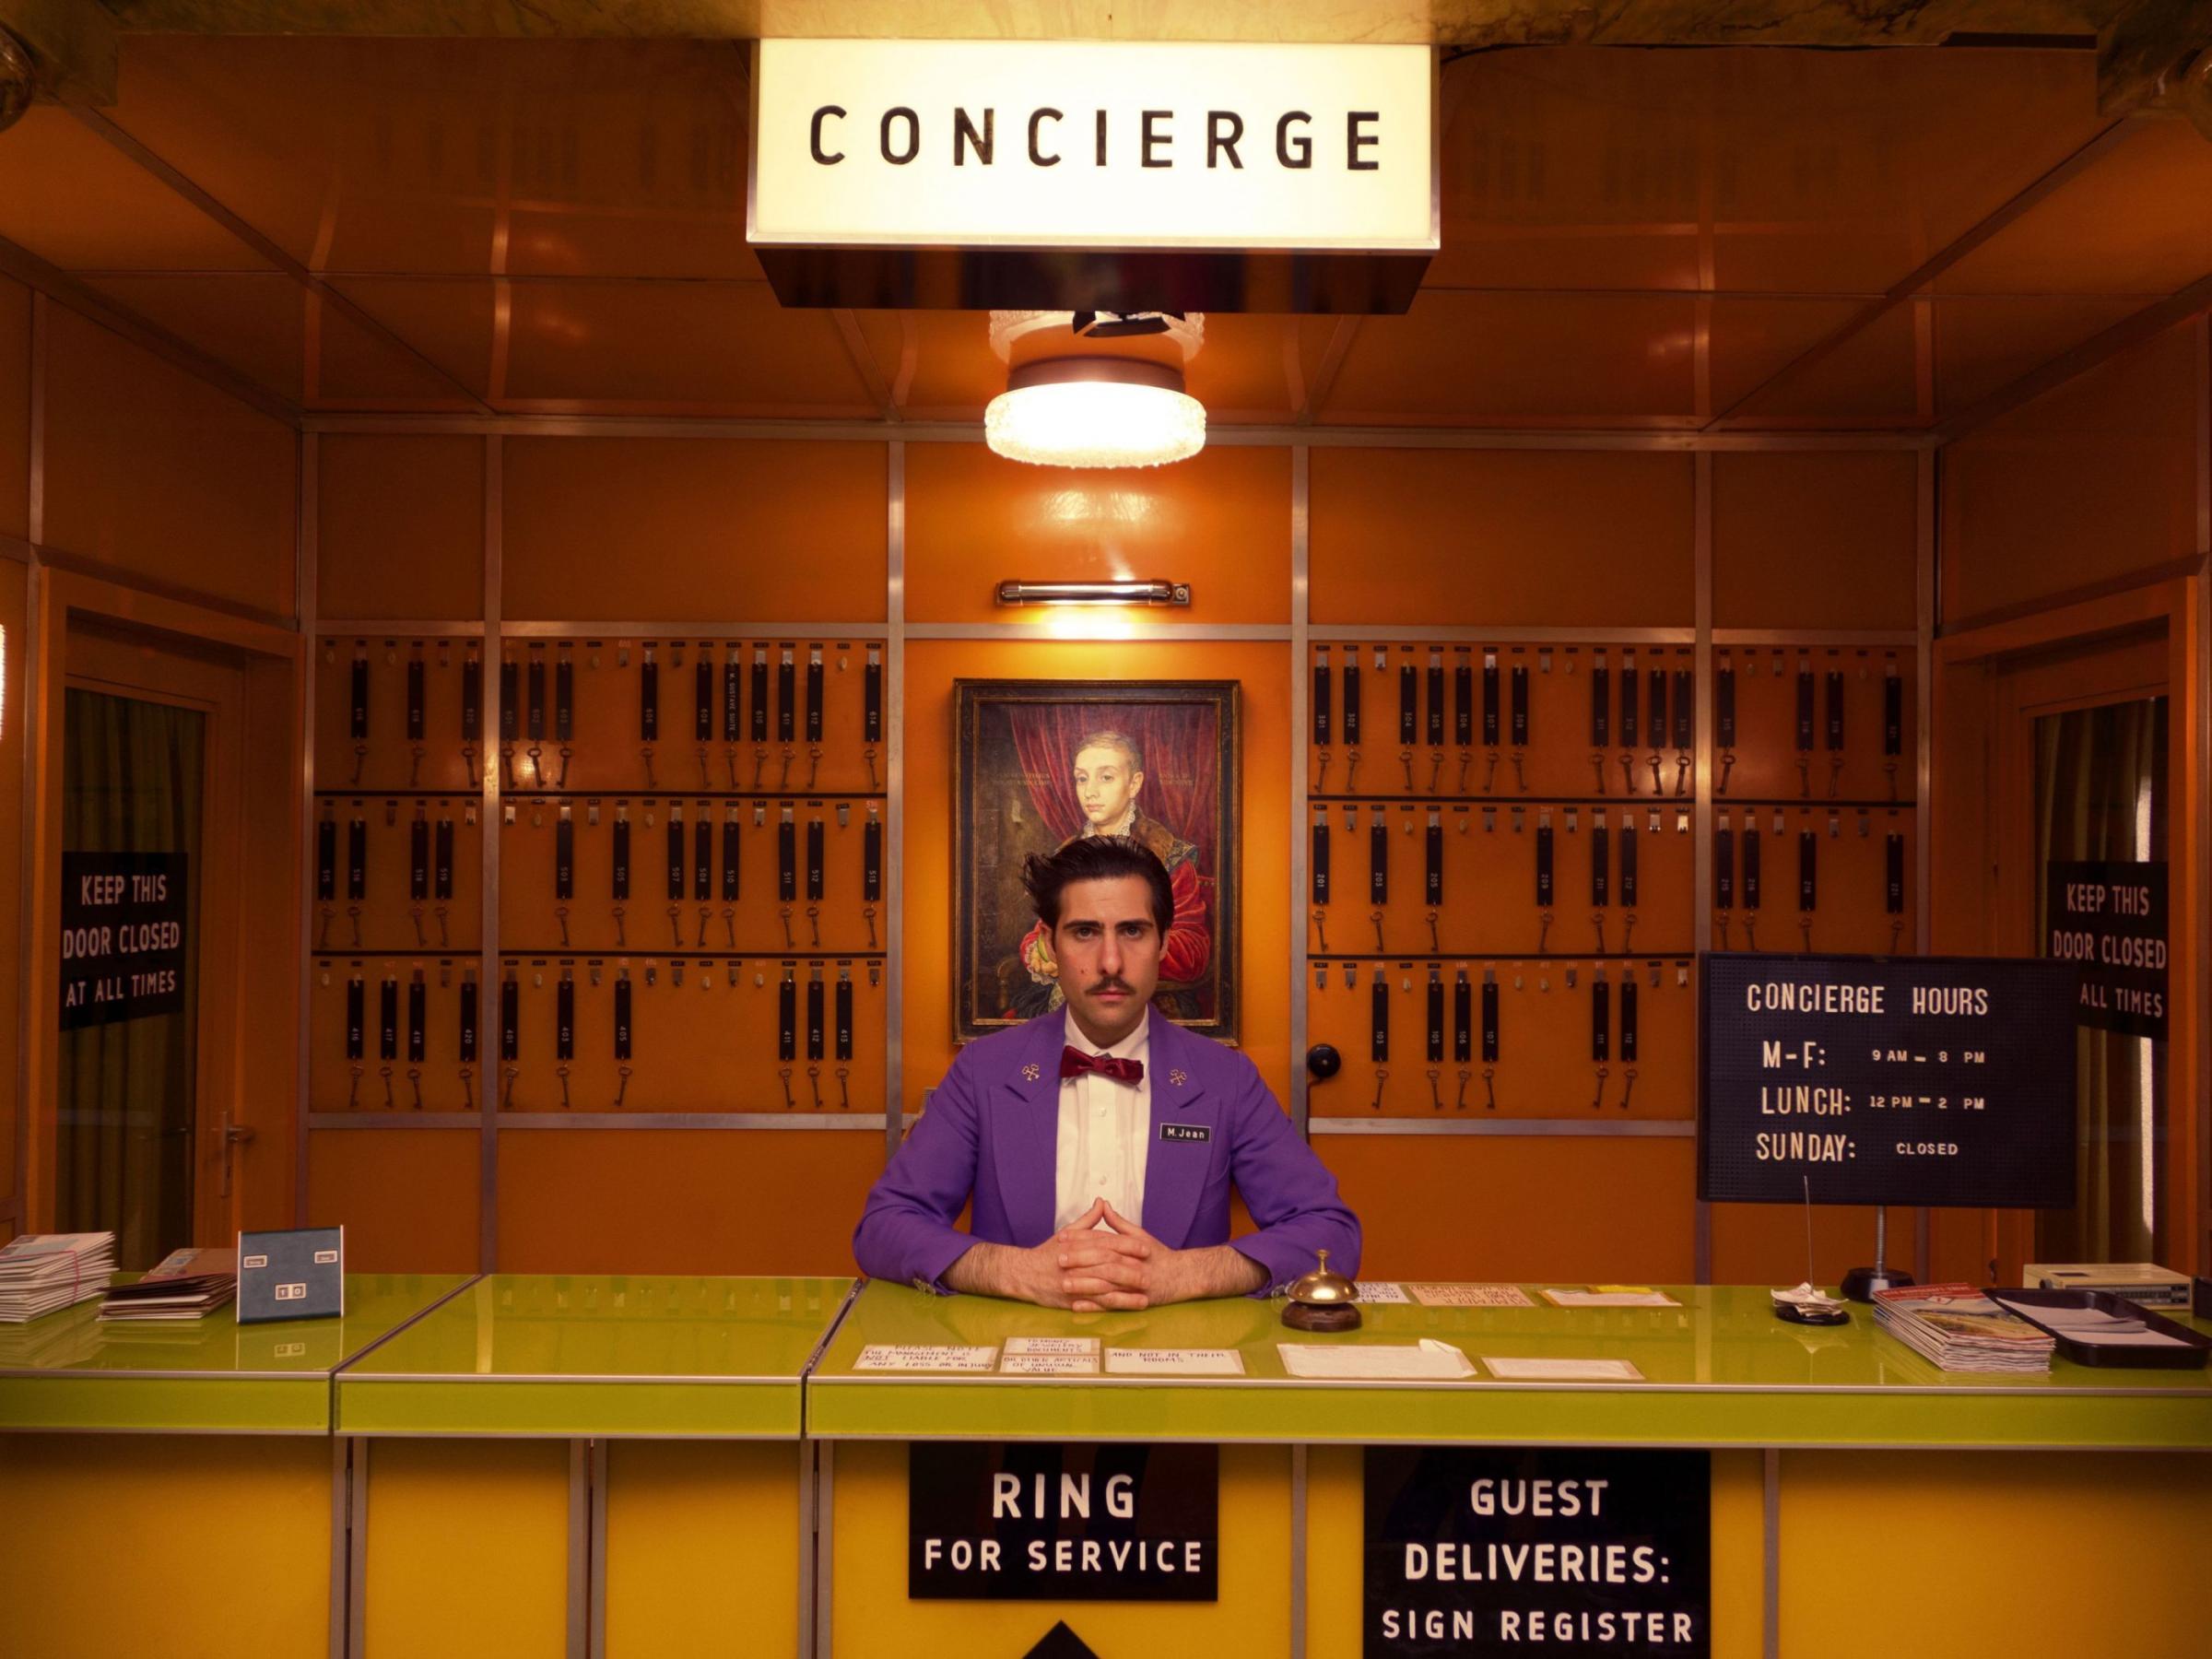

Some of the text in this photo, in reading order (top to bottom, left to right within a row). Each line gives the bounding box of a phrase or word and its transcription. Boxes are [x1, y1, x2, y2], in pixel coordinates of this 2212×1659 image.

[810, 105, 1379, 171] CONCIERGE
[728, 682, 736, 710] GUSTAVE
[728, 712, 737, 731] SUITE
[755, 710, 764, 724] 610
[782, 712, 791, 725] 611
[810, 711, 818, 725] 612
[869, 711, 877, 725] 614
[1318, 714, 1326, 729] 301
[1347, 712, 1356, 728] 302
[1431, 713, 1441, 729] 305
[1459, 712, 1468, 728] 306
[322, 869, 331, 883] 515
[440, 867, 448, 882] 519
[617, 866, 626, 882] 505
[671, 866, 680, 882] 507
[726, 869, 735, 884] 510
[782, 871, 792, 884] 511
[811, 869, 819, 883] 512
[1316, 873, 1325, 888] 201
[1374, 872, 1383, 888] 203
[1430, 872, 1439, 888] 205
[82, 875, 166, 905] KEEP THIS
[2067, 884, 2148, 915] KEEP THIS
[64, 922, 179, 959] DOOR CLOSED
[2053, 930, 2166, 969] DOOR CLOSED
[66, 971, 174, 1006] AT ALL TIMES
[1747, 983, 1987, 1015] CONCIERGE HOURS
[2080, 984, 2162, 1018] ALL TIMES
[351, 1027, 359, 1041] 416
[385, 1028, 394, 1041] 417
[413, 1030, 421, 1044] 418
[464, 1029, 473, 1044] 420
[506, 1029, 514, 1044] 401
[561, 1026, 570, 1042] 403
[618, 1025, 628, 1041] 405
[783, 1030, 792, 1043] 411
[811, 1029, 820, 1042] 412
[1376, 1030, 1384, 1044] 103
[1431, 1030, 1440, 1044] 105
[1458, 1030, 1467, 1044] 106
[1486, 1030, 1495, 1044] 107
[1596, 1033, 1605, 1044] 111
[1624, 1032, 1633, 1044] 112
[1763, 1041, 1825, 1068] M-F:
[1873, 1050, 1880, 1061] 9
[1888, 1051, 1907, 1061] AM
[1939, 1052, 1947, 1062] 8
[1964, 1052, 1984, 1063] PM
[1762, 1087, 1850, 1114] LUNCH:
[1871, 1096, 1885, 1107] 12
[1892, 1097, 1912, 1107] PM
[1938, 1098, 1947, 1109] 2
[1964, 1099, 1983, 1109] PM
[1167, 1127, 1205, 1139] M. Jean
[1757, 1133, 1958, 1161] SUNDAY: CLOSED
[994, 1474, 1133, 1518] RING
[1472, 1479, 1607, 1516] GUEST
[925, 1539, 1200, 1571] FOR SERVICE
[1406, 1544, 1668, 1583] DELIVERIES:
[1382, 1610, 1691, 1641] SIGN REGISTER
